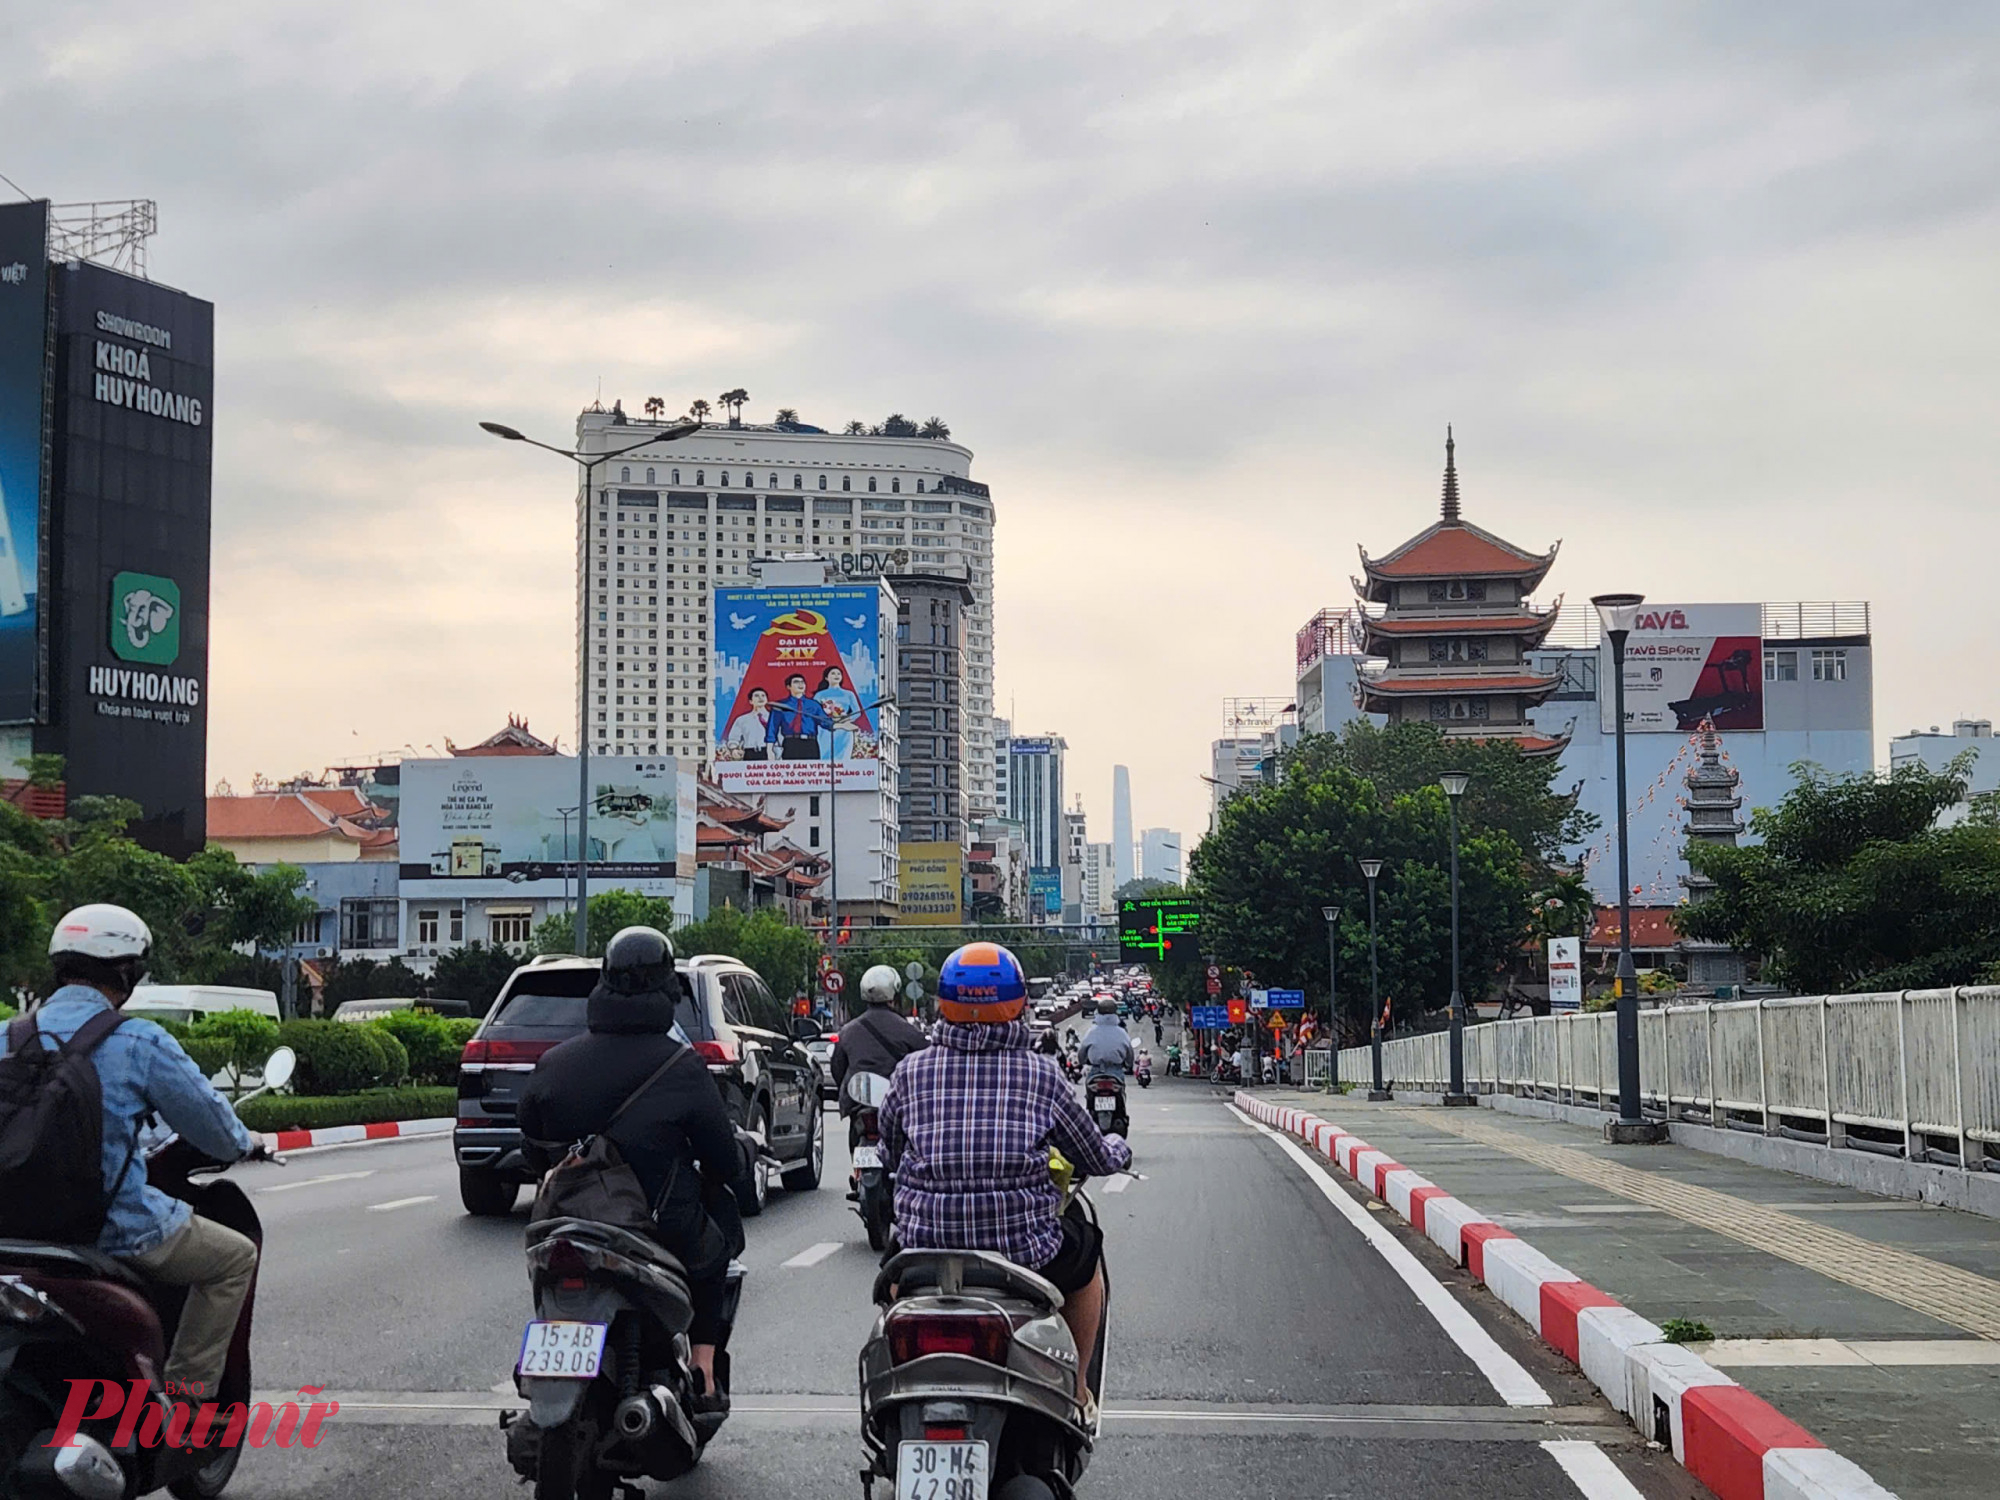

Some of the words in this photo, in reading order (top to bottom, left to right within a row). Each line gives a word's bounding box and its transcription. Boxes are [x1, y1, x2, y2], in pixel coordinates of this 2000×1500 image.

[96, 311, 170, 349] SHOWROOM
[96, 341, 151, 382] KHOÁ
[95, 372, 202, 426] HUYHOANG
[842, 552, 890, 572] BIDV
[776, 646, 819, 660] XIV
[779, 639, 796, 647] ĐẠI
[90, 666, 199, 706] HUYHOANG
[121, 706, 131, 716] an
[453, 783, 482, 793] Legend
[541, 1325, 594, 1347] 15-AB
[525, 1350, 596, 1372] 239.06
[912, 1446, 976, 1474] 30-M4
